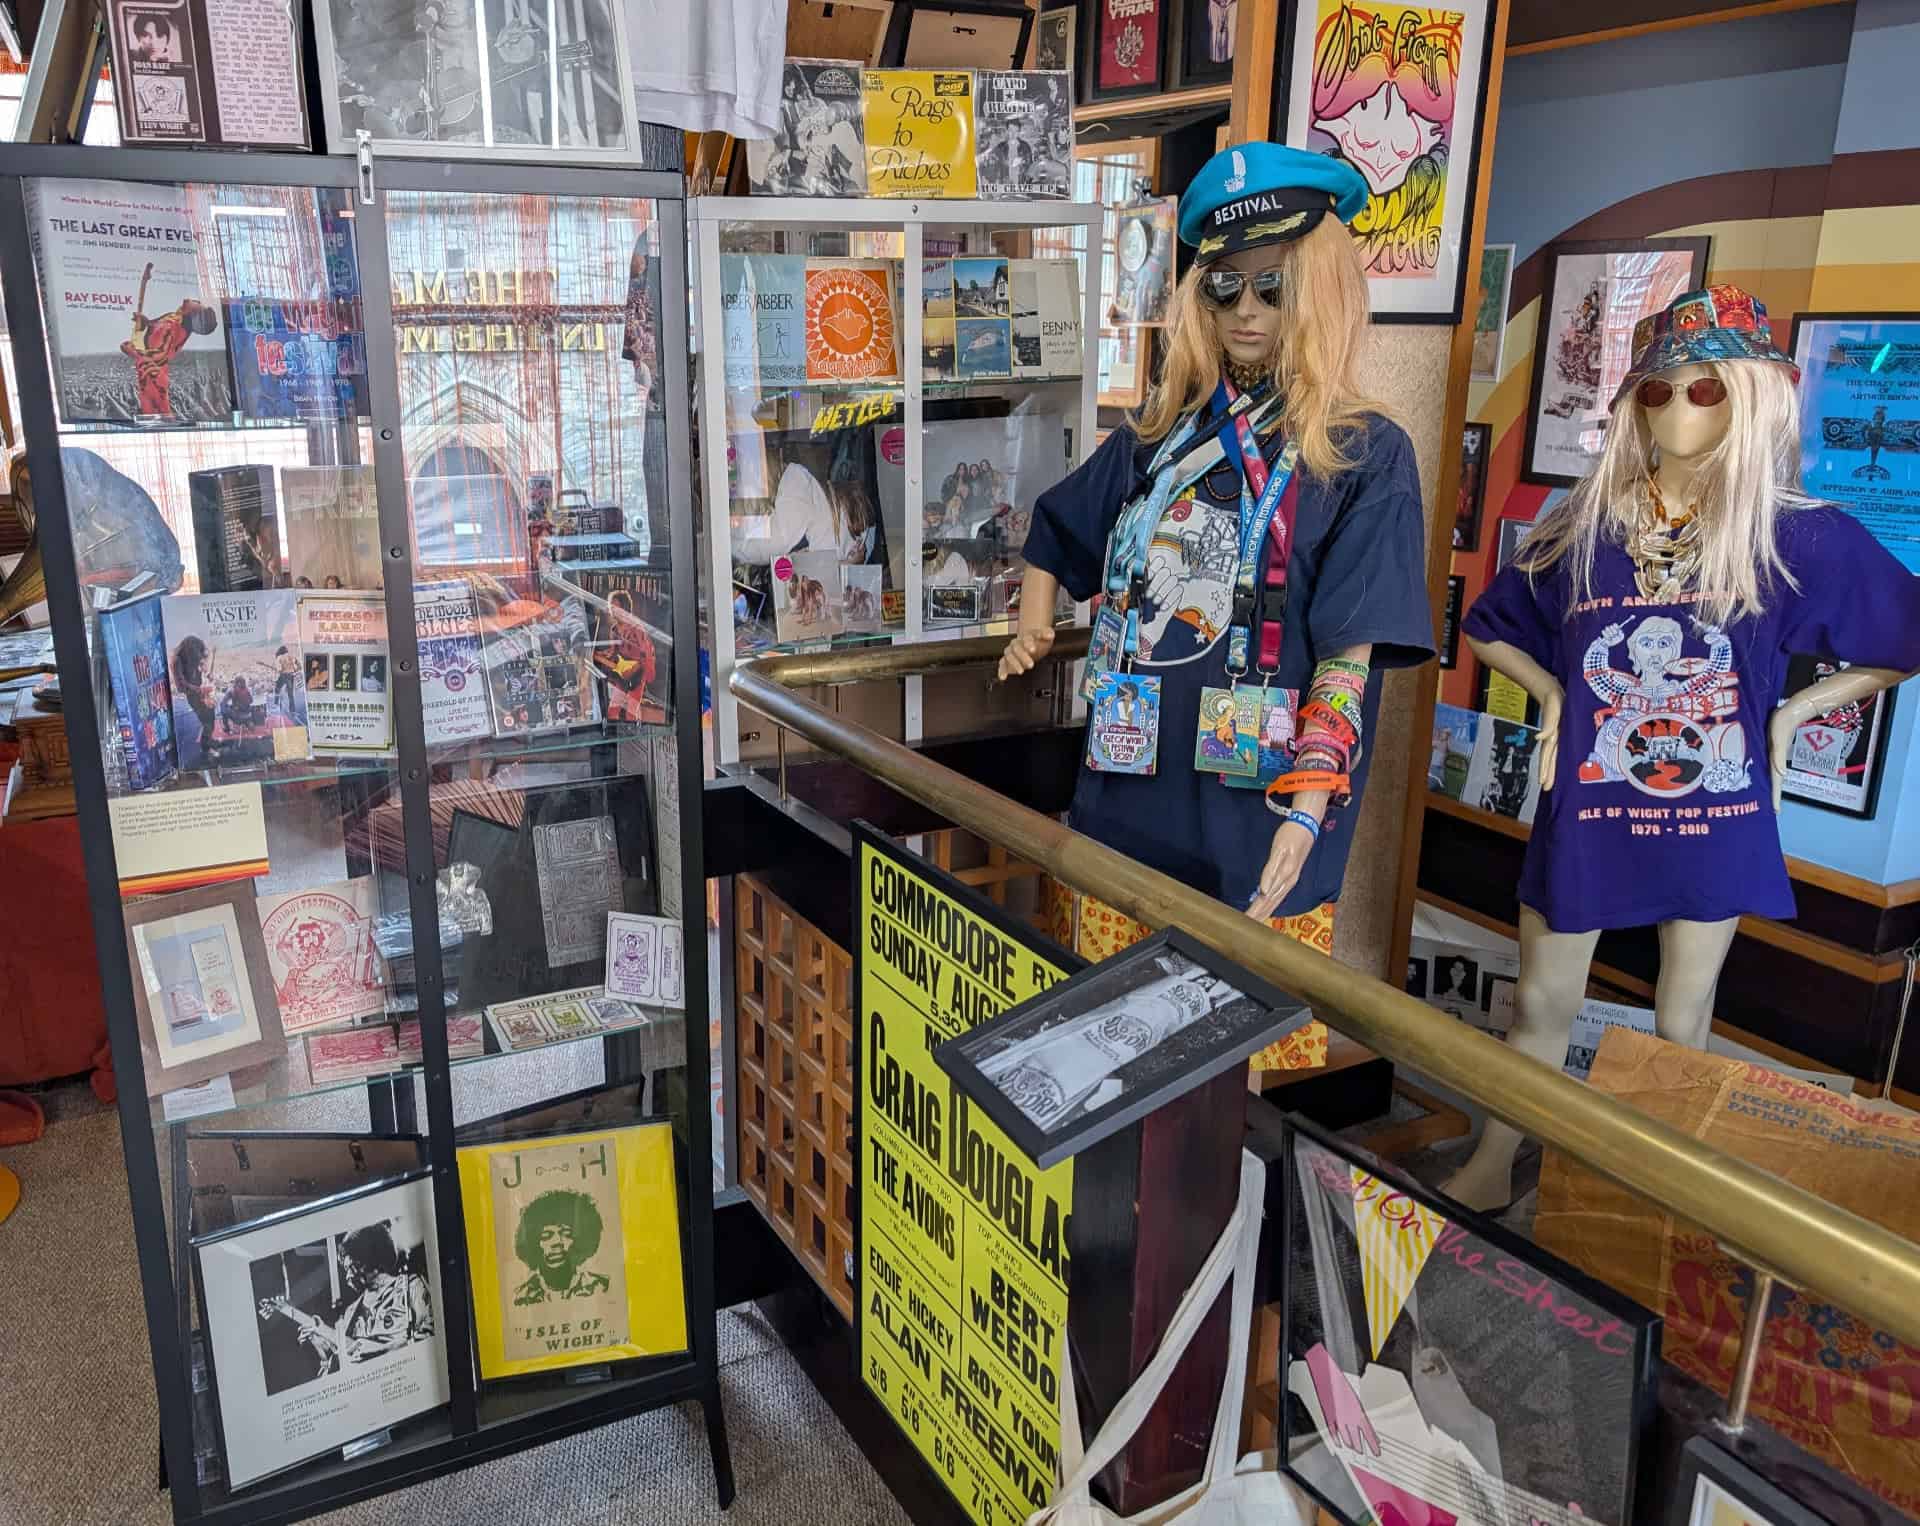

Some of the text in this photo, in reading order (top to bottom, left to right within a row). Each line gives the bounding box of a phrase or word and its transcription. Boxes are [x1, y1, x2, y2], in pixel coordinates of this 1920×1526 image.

[891, 86, 954, 124] Rags
[893, 121, 912, 147] to
[872, 148, 951, 182] Riches
[1214, 194, 1284, 226] BESTIVAL
[49, 218, 163, 240] THE LAST GREAT
[64, 292, 133, 305] RAY FOULK
[1042, 320, 1080, 332] PENNY
[1820, 485, 1866, 493] JEFFERSON
[202, 606, 257, 623] TASTE
[1103, 734, 1115, 744] ISLE
[1125, 735, 1145, 745] WIGHT
[1111, 745, 1135, 753] FESTIVAL
[1606, 808, 1623, 818] OF
[1628, 808, 1671, 818] WIGHT
[1676, 808, 1702, 818] POP
[1707, 800, 1759, 818] FESTIVAL
[1631, 824, 1661, 835] 1970
[1678, 824, 1710, 835] 2010
[870, 855, 1017, 999] COMMODORE
[870, 914, 941, 997] SUNDAY
[930, 999, 961, 1035] 5.30
[870, 1011, 942, 1165] CRAIG
[503, 1144, 607, 1188] J H
[912, 1160, 933, 1186] VOCAL
[937, 1187, 951, 1204] TRIO
[870, 1135, 955, 1261] THE AVONS
[977, 1223, 992, 1241] TOP
[1003, 1262, 1048, 1312] RECORDING
[1379, 1192, 1422, 1238] On
[1490, 1259, 1635, 1357] Street
[869, 1245, 954, 1360] EDDIE HICKEY
[990, 1267, 1056, 1359] BERT
[581, 1319, 603, 1331] OF
[970, 1285, 1061, 1414] WEEDO
[870, 1289, 932, 1383] ALAN
[940, 1367, 1047, 1509] FREEMA
[967, 1353, 1060, 1478] ROY YOUN
[903, 1383, 915, 1400] All
[918, 1399, 942, 1434] Seats
[947, 1435, 991, 1493] Bookable
